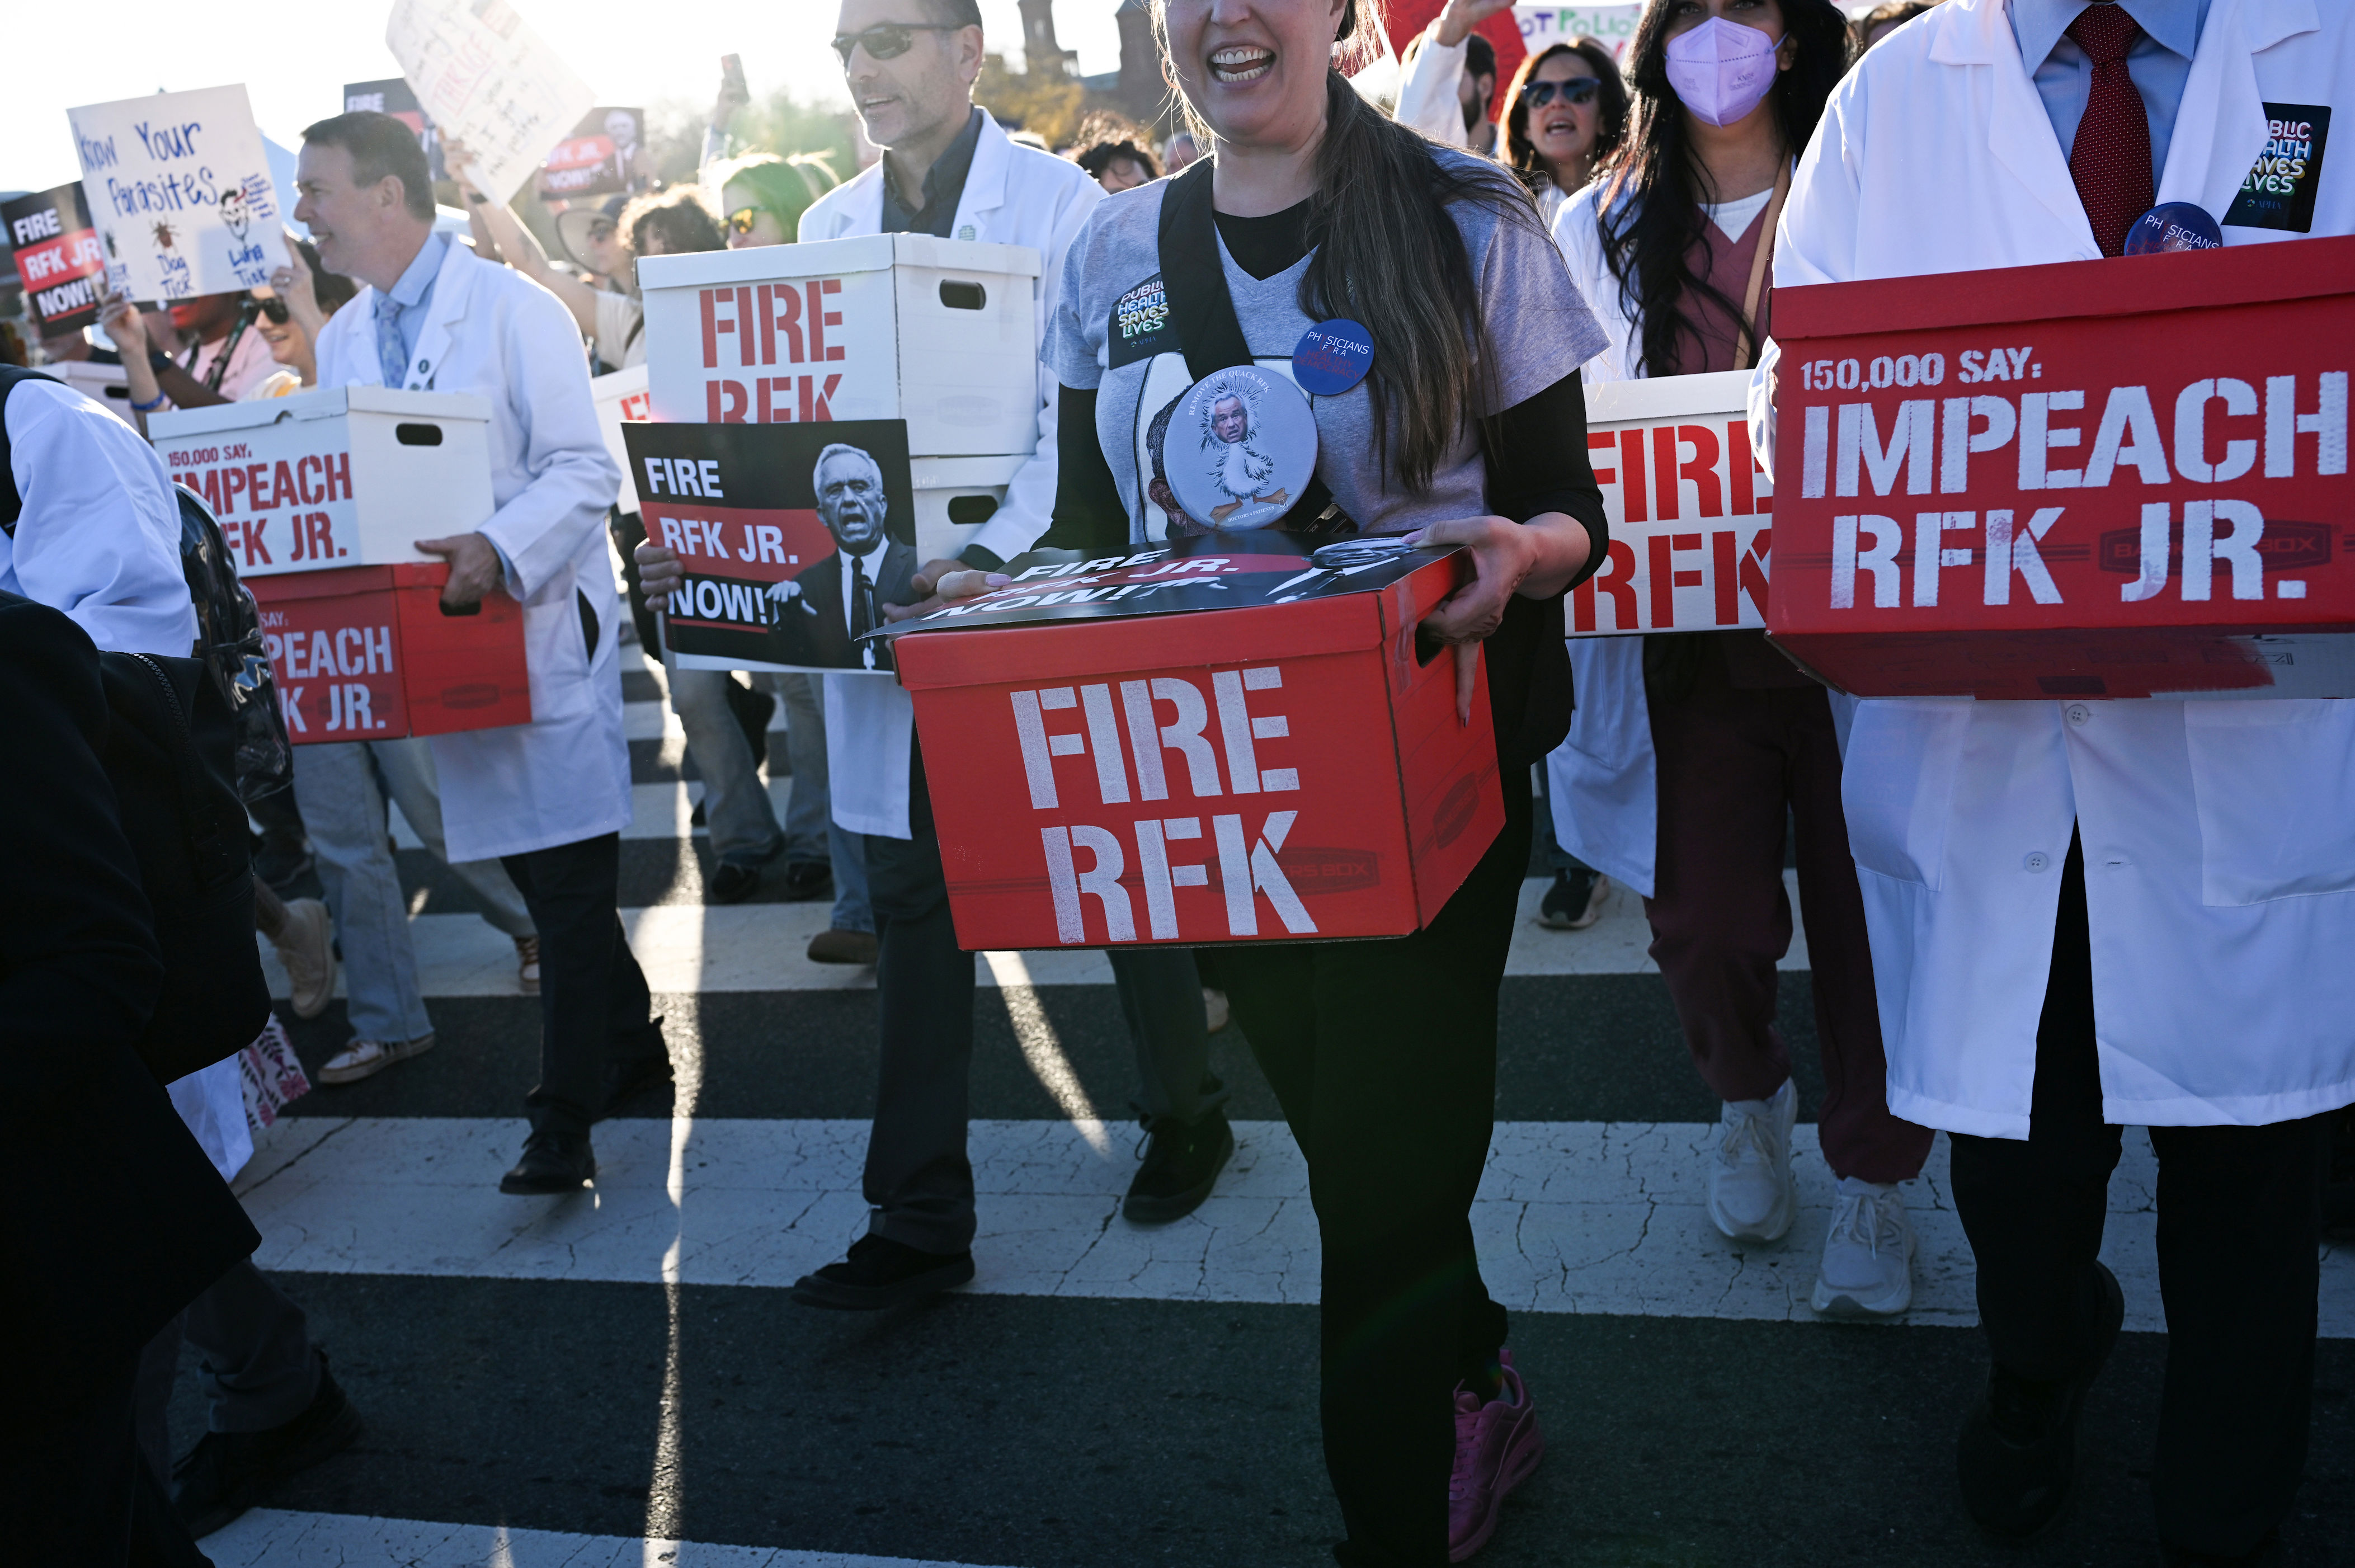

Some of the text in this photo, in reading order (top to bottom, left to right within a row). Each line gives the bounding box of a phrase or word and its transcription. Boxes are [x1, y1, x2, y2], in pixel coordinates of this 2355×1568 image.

[2263, 138, 2310, 158] ALTH
[2266, 119, 2311, 140] BLIC
[2252, 156, 2305, 176] AVES
[13, 208, 61, 246] FIRE
[24, 247, 67, 281] RFK
[36, 279, 95, 318] NOW!
[1120, 280, 1164, 303] PUBLI
[699, 279, 845, 368] FIRE
[1118, 302, 1169, 327] SAVES
[1123, 316, 1164, 338] LIVES
[1293, 355, 1361, 380] DEMOCRACY
[1306, 350, 1354, 369] HEALTHY
[1801, 346, 2042, 392] 150,000 SAY:
[1189, 370, 1272, 416] REMOVE THE QUACK RFK
[1801, 370, 2349, 499] IMPEACH
[168, 447, 219, 467] 150,000
[172, 452, 353, 517] MPEACH
[644, 457, 723, 498] FIRE
[1228, 513, 1250, 523] DOCTORS
[1252, 505, 1275, 516] PATIENTS
[290, 512, 347, 561] JR.
[659, 517, 799, 564] RFK JR.
[1830, 499, 2306, 610] RFK JR.
[1011, 548, 1172, 582] FIRE
[1128, 558, 1240, 578] JR.
[668, 579, 768, 624] NOW!
[919, 585, 1142, 622] NOW!
[326, 684, 386, 731] JR.
[1010, 666, 1301, 809] FIRE
[1040, 810, 1318, 944] RFK
